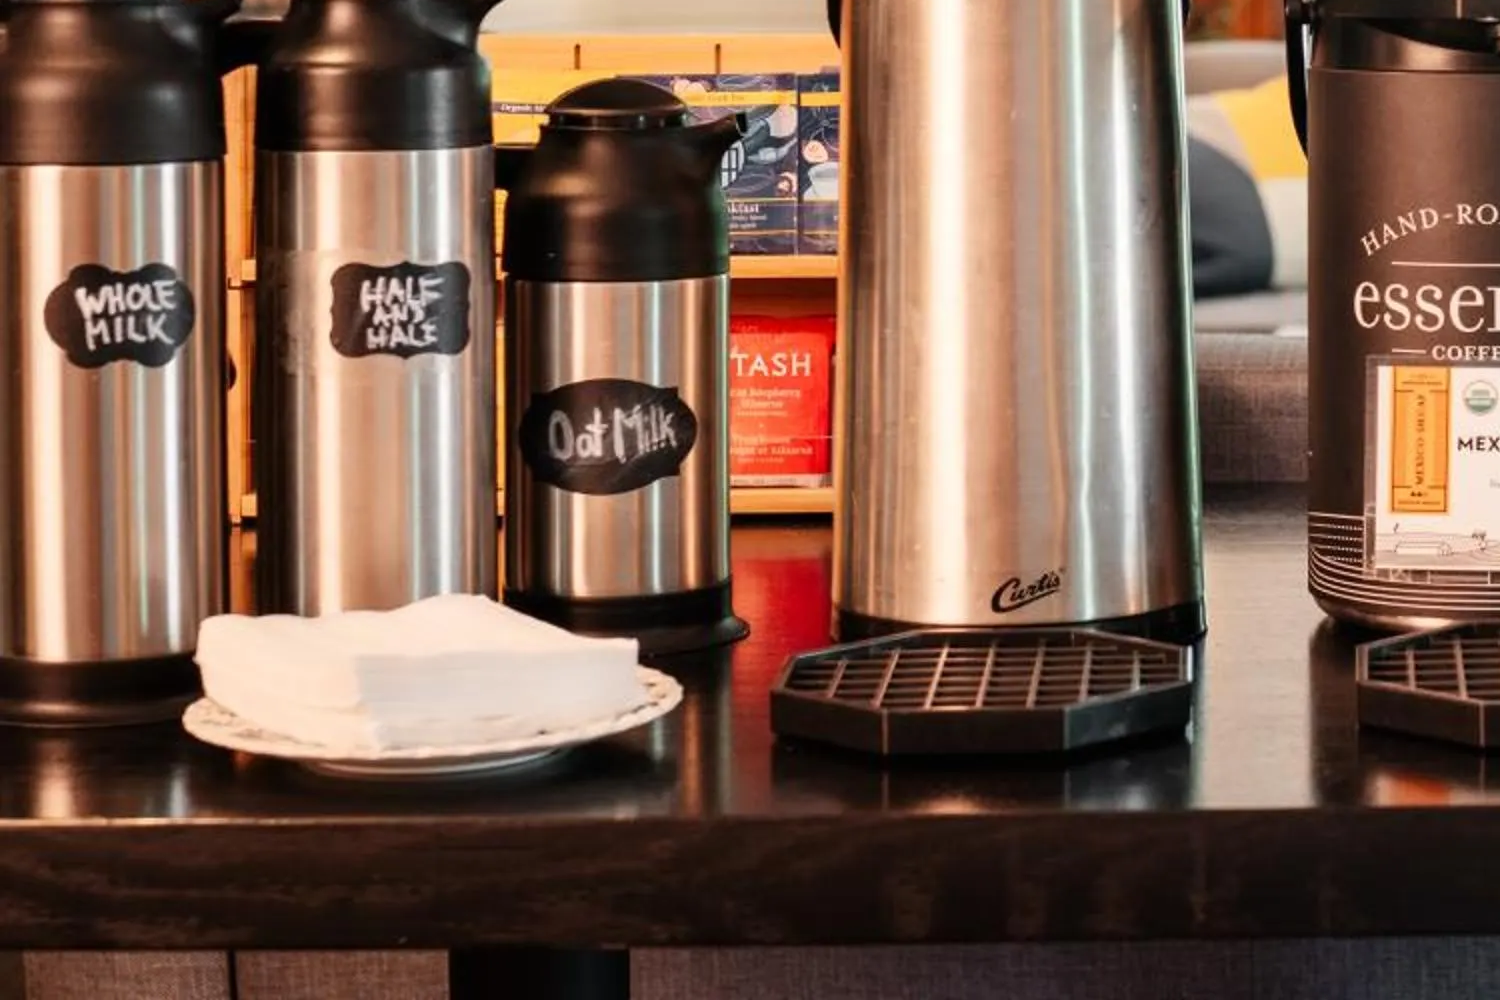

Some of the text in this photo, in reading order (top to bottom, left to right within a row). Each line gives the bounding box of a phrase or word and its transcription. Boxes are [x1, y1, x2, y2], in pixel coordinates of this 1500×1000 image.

[75, 280, 176, 319] WHOLE
[361, 275, 444, 313] HALF
[85, 312, 174, 351] MILK
[373, 300, 425, 327] AND
[730, 350, 812, 377] TASH
[549, 404, 678, 464] Oat Milk
